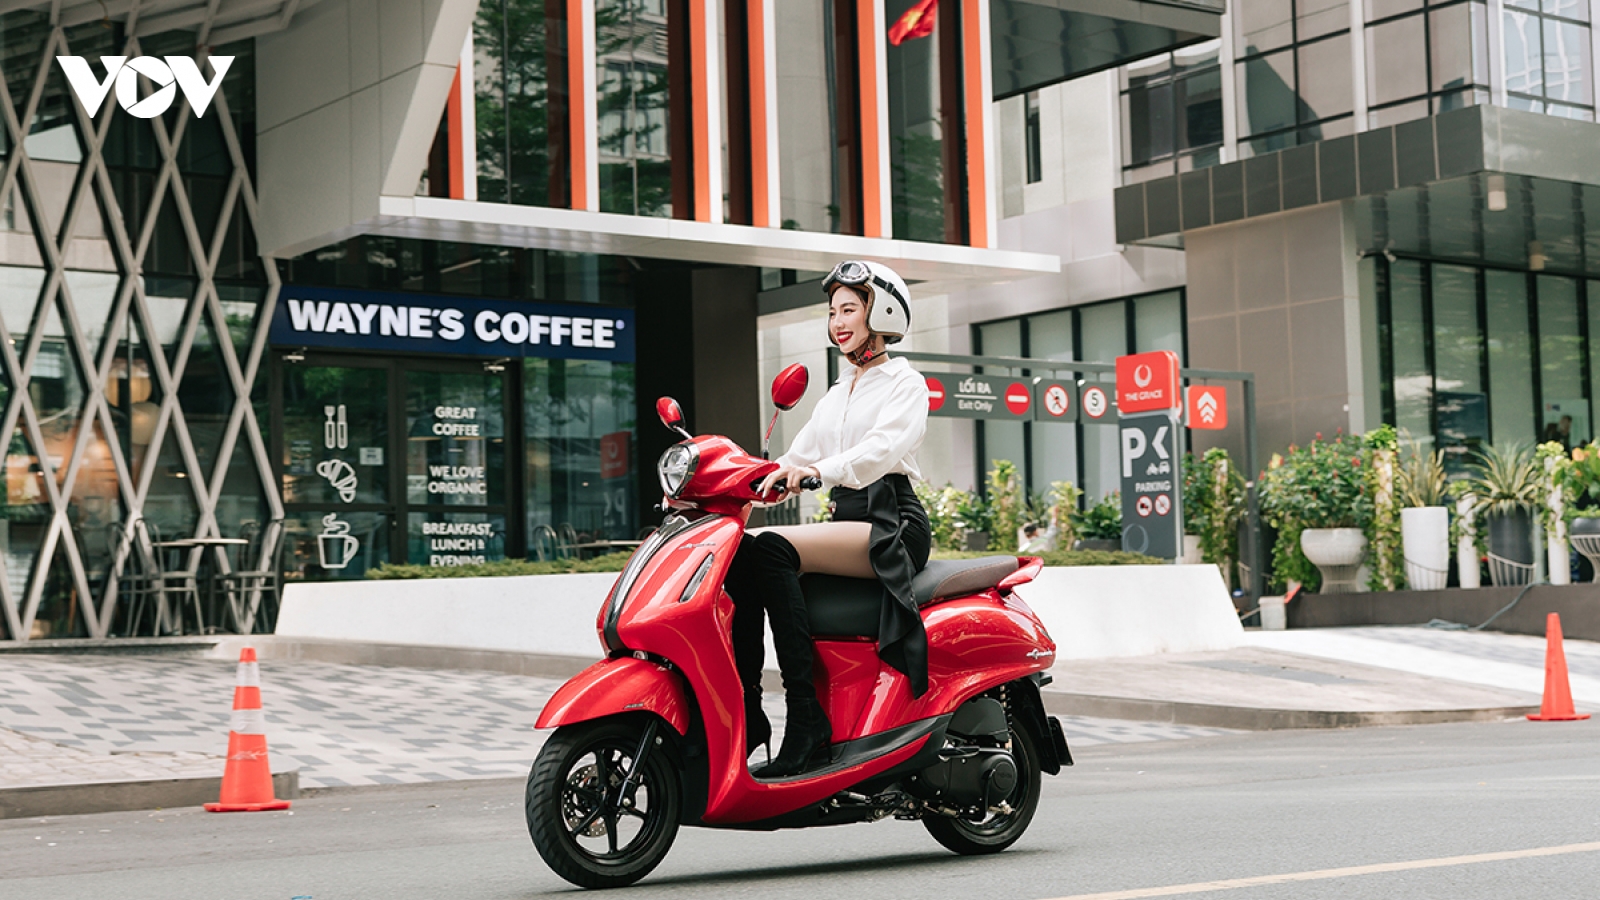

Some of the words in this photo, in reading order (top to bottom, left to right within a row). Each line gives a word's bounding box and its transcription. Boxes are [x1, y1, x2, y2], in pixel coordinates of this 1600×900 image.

[474, 310, 616, 349] COFFEE
[977, 381, 992, 394] RA
[1091, 392, 1099, 407] 5
[1125, 392, 1138, 401] THE
[1139, 389, 1163, 400] GRACE
[958, 399, 974, 410] Exit
[975, 400, 993, 412] Only
[434, 406, 477, 419] GREAT
[432, 422, 480, 437] COFFEE
[429, 465, 451, 477] WE
[452, 466, 485, 478] LOVE
[427, 482, 487, 494] ORGANIC
[1135, 481, 1172, 493] PARKING
[422, 522, 495, 537] BREAKFAST,
[431, 539, 476, 551] LUNCH
[430, 554, 485, 568] EVENING
